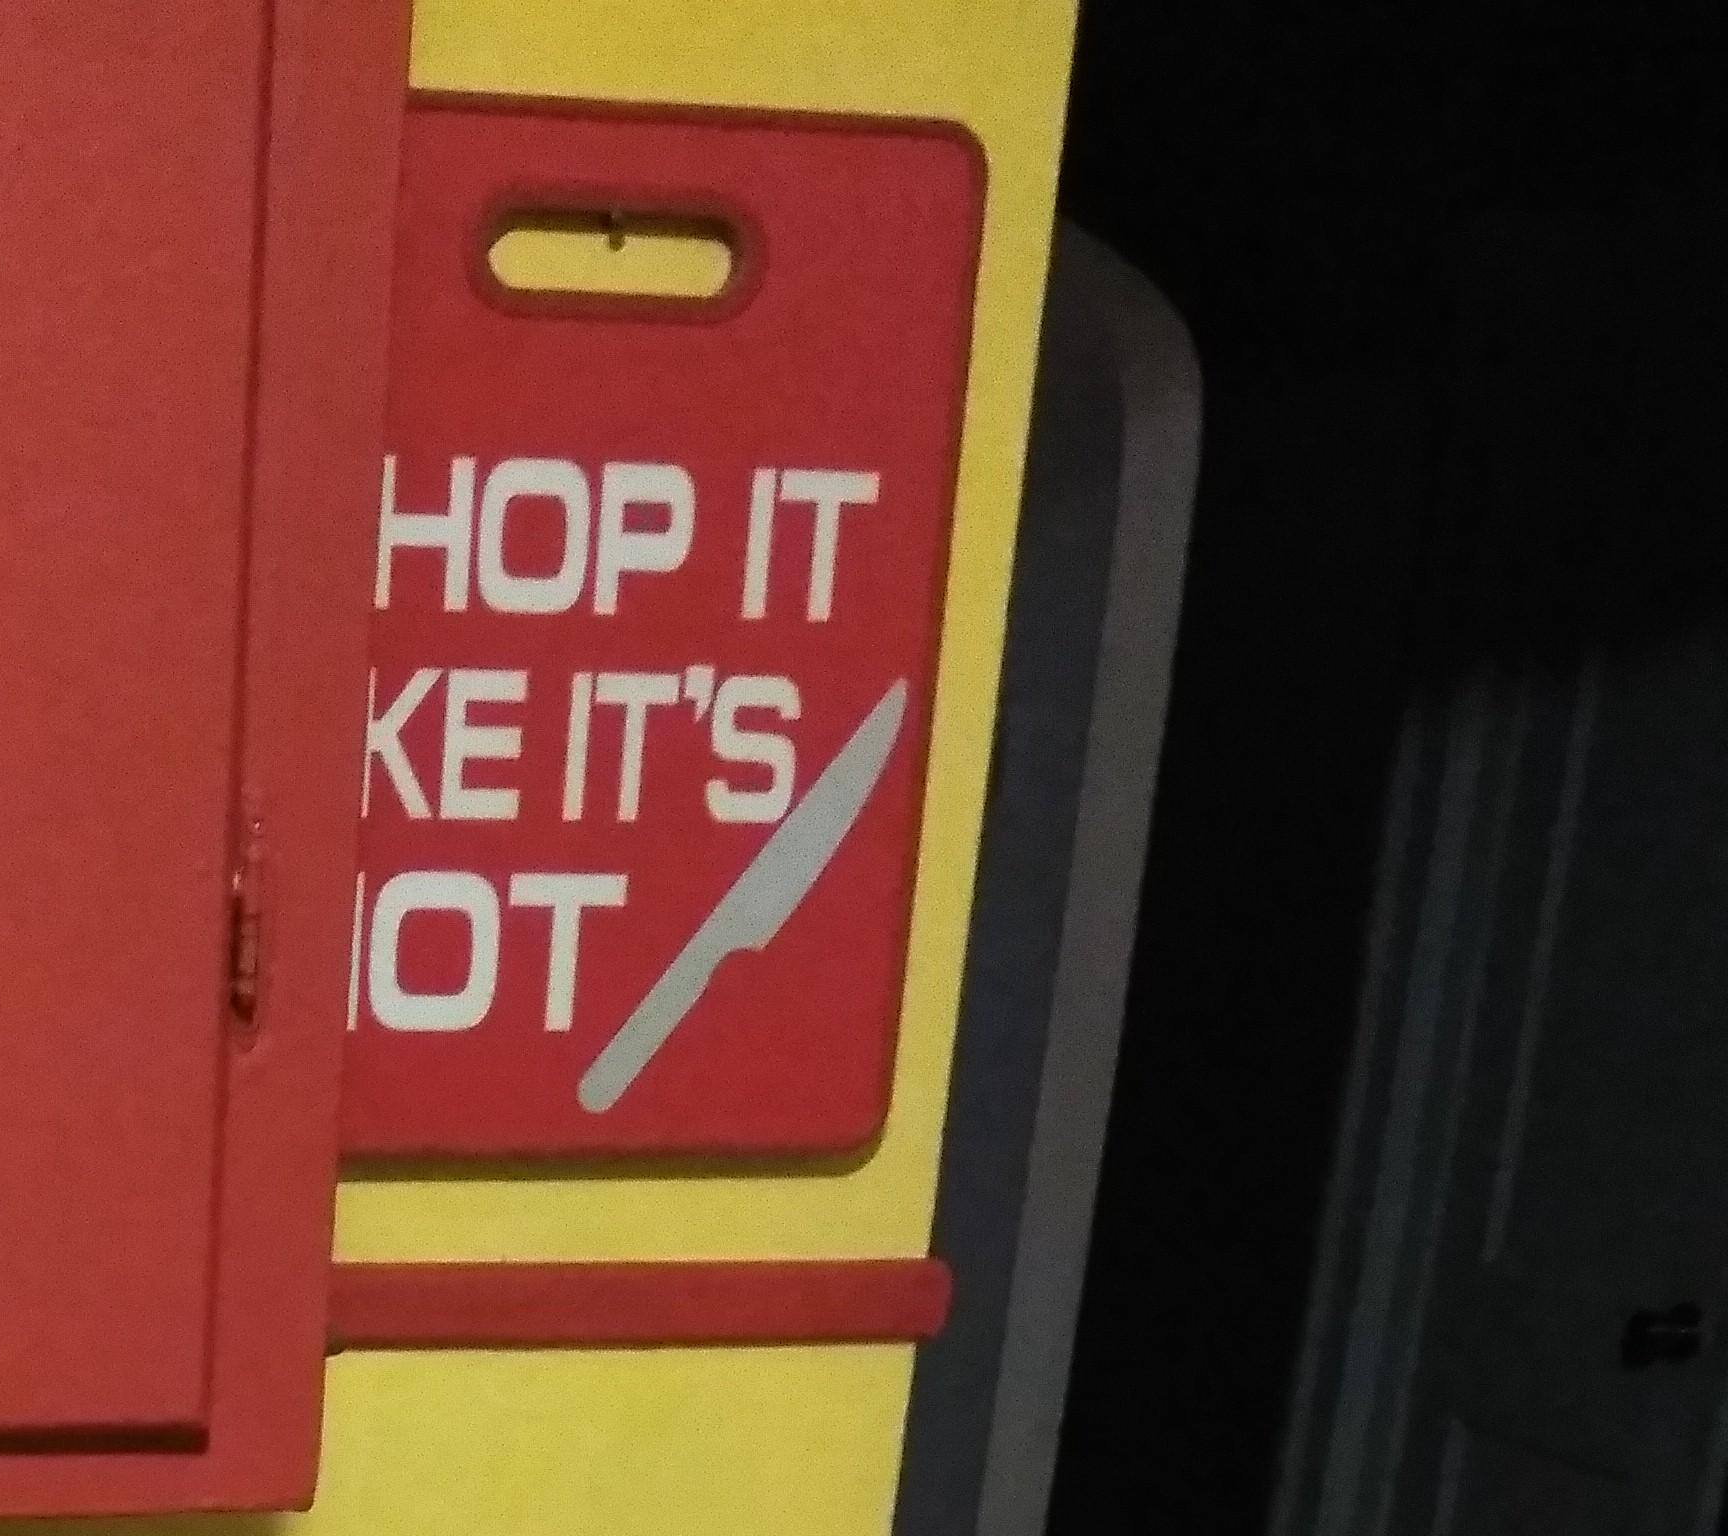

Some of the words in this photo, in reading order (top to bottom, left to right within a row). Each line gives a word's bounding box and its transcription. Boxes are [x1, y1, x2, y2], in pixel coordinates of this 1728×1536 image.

[741, 466, 882, 623] IT
[561, 662, 803, 823] IT'S
[346, 870, 628, 1033] OT
